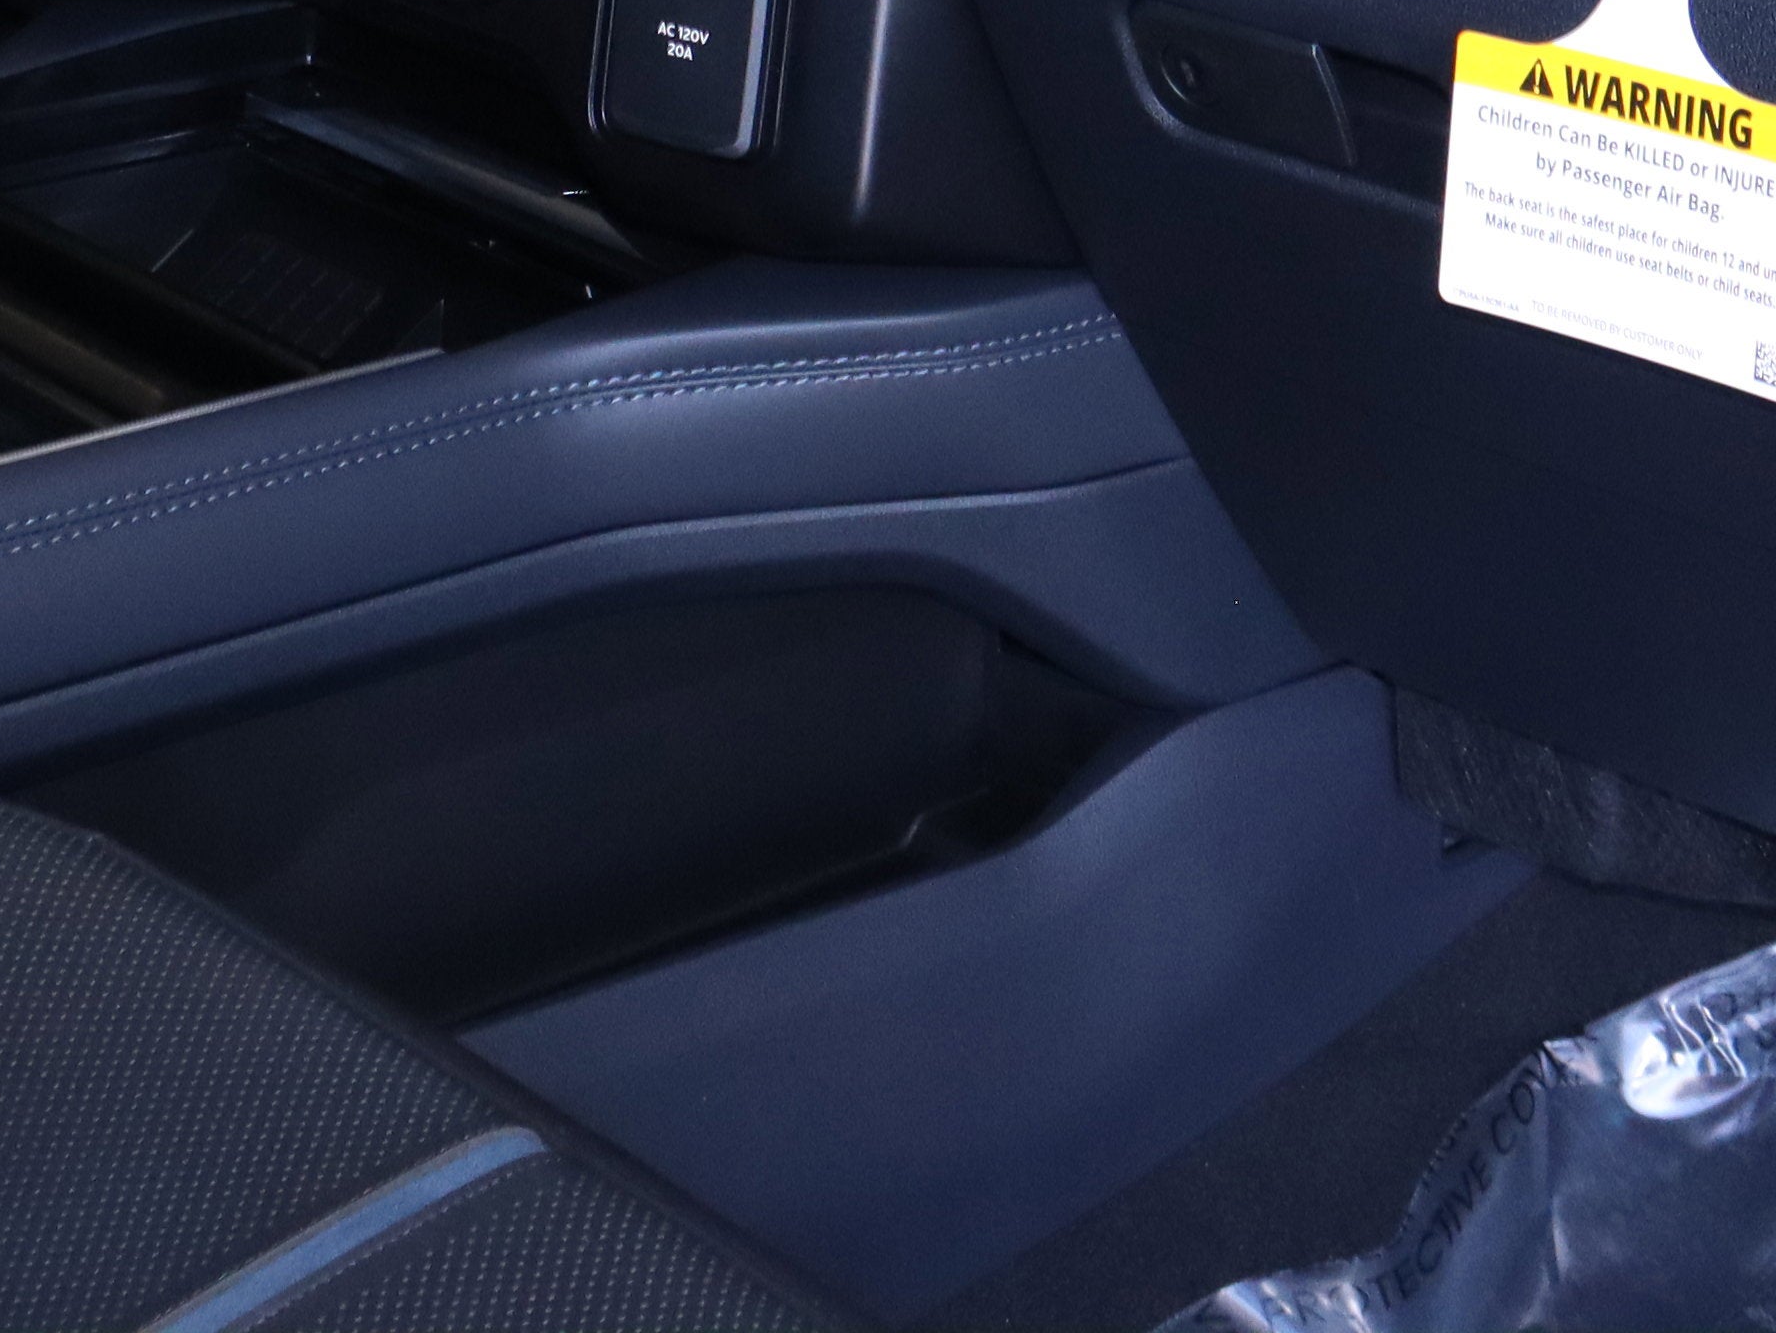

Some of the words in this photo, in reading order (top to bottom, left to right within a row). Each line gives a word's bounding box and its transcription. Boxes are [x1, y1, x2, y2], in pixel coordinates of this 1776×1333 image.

[657, 20, 677, 39] AC
[677, 25, 710, 46] 120V
[667, 41, 694, 62] 20A
[1477, 105, 1553, 139] Children
[1559, 125, 1591, 149] Can
[1597, 133, 1619, 152] Be
[1624, 141, 1685, 172] KILLED
[1690, 162, 1709, 179] or
[1564, 64, 1754, 151] WARNING
[1536, 151, 1557, 179] by
[1562, 159, 1653, 199] Passenger
[1656, 185, 1683, 207] Air
[1688, 193, 1725, 224] Bag.
[1464, 180, 1485, 201] The
[1489, 187, 1515, 208] back
[1519, 196, 1542, 215] seat
[1546, 201, 1555, 218] is
[1559, 205, 1578, 225] the
[1581, 214, 1615, 235] safest
[1618, 223, 1648, 245] place
[1652, 230, 1669, 249] for
[1671, 238, 1718, 264] children
[1722, 252, 1735, 270] 12
[1738, 258, 1760, 277] and
[1485, 212, 1517, 234] Make
[1520, 223, 1545, 242] sure
[1548, 229, 1563, 246] all
[1566, 235, 1613, 260] children
[1615, 249, 1636, 267] use
[1639, 255, 1663, 275] seat
[1666, 262, 1694, 285] belts
[1697, 273, 1710, 288] or
[1713, 276, 1740, 298] child
[1743, 286, 1776, 310] seats.
[1531, 299, 1545, 314] TO
[1547, 304, 1559, 319] BE
[1561, 309, 1607, 332] REMOVED
[1609, 322, 1621, 336] BY
[1622, 326, 1675, 353] CUSTOMER
[1677, 343, 1704, 362] ONLY
